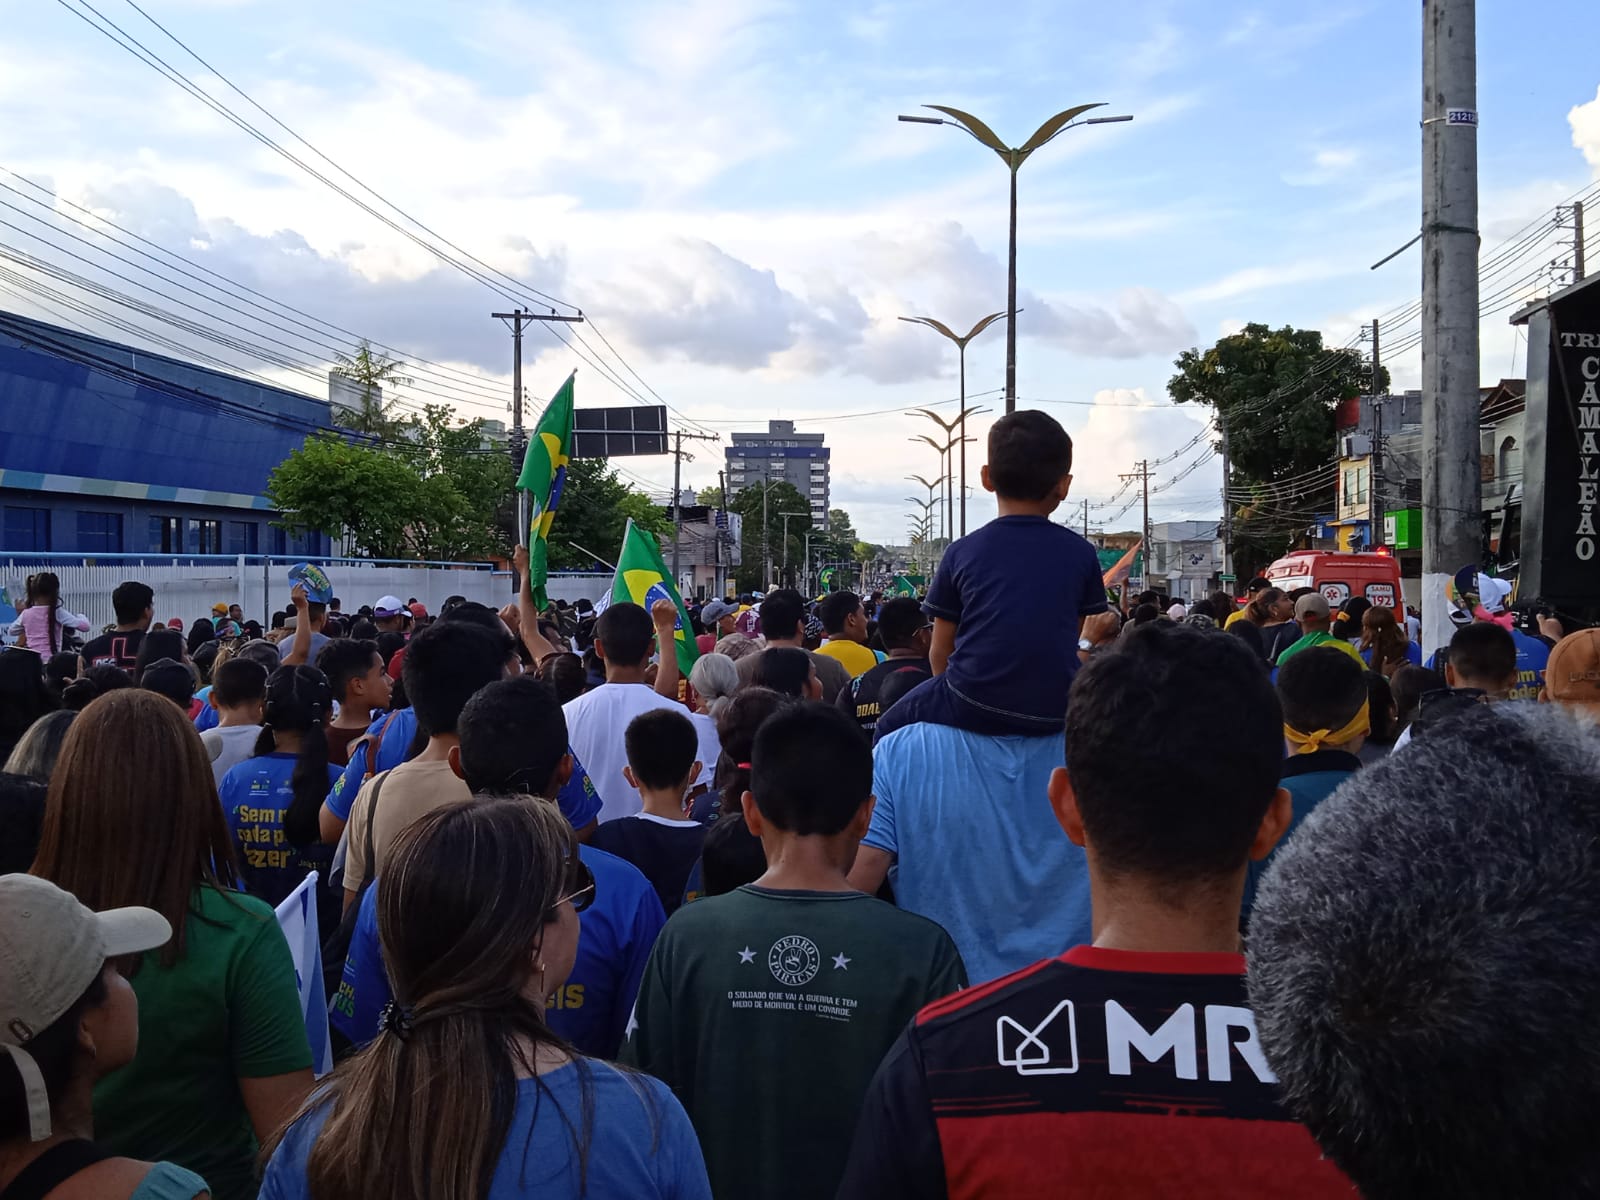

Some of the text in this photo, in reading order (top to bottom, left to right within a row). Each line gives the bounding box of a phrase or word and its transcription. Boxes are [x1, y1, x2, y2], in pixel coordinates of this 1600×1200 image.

[1576, 356, 1600, 561] CAMALEÃO
[1371, 595, 1392, 606] 192
[774, 937, 816, 956] PEDRO
[770, 960, 818, 984] PARACAS
[727, 991, 733, 999] O
[735, 991, 767, 999] SOLDADO
[768, 992, 784, 1001] QUE
[785, 992, 797, 1001] VAI
[806, 994, 833, 1005] GUERRA
[835, 997, 840, 1005] E
[842, 998, 858, 1008] TEM
[732, 1000, 753, 1008] MEDO
[754, 1000, 763, 1009] DE
[804, 1002, 817, 1012] UM
